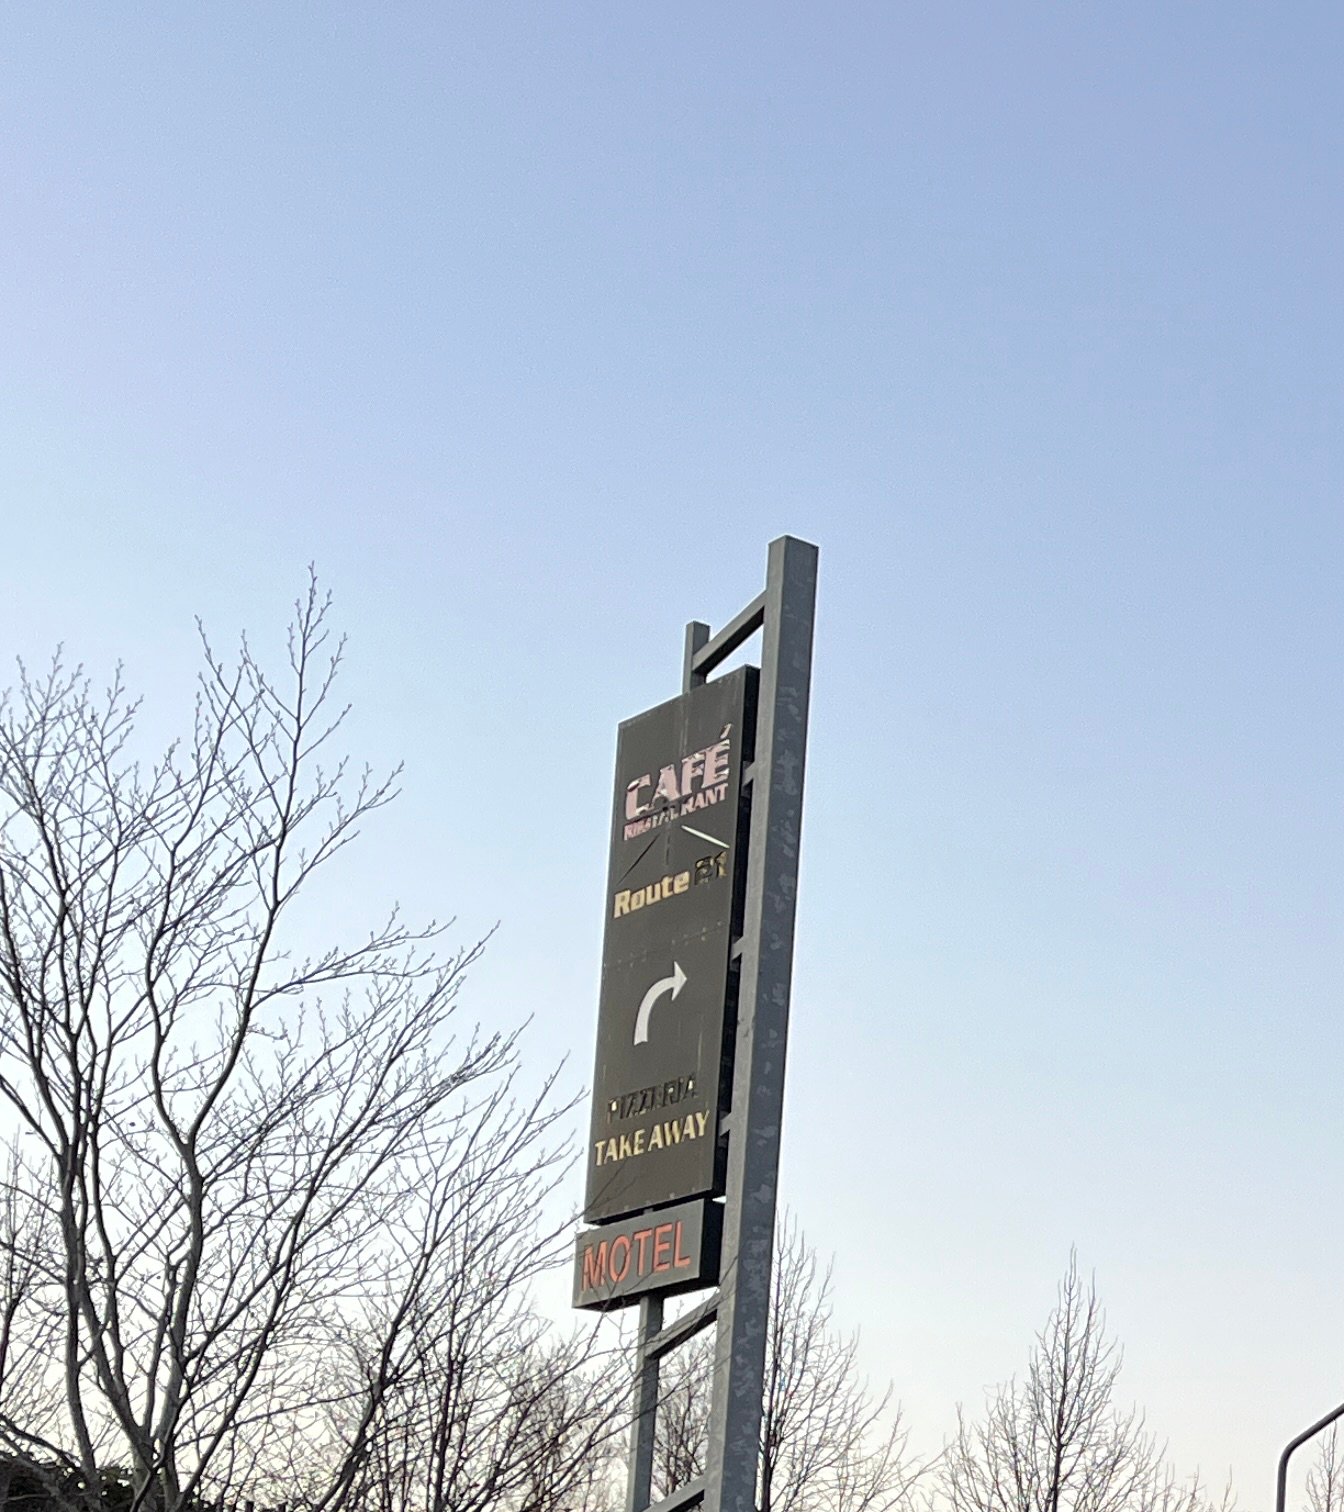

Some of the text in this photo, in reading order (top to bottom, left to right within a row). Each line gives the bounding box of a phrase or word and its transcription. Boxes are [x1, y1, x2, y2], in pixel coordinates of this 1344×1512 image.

[625, 723, 731, 820] CAFÉ
[613, 870, 690, 919] Route
[595, 1109, 710, 1166] TAKE AWAY
[581, 1220, 691, 1292] MOTEL
